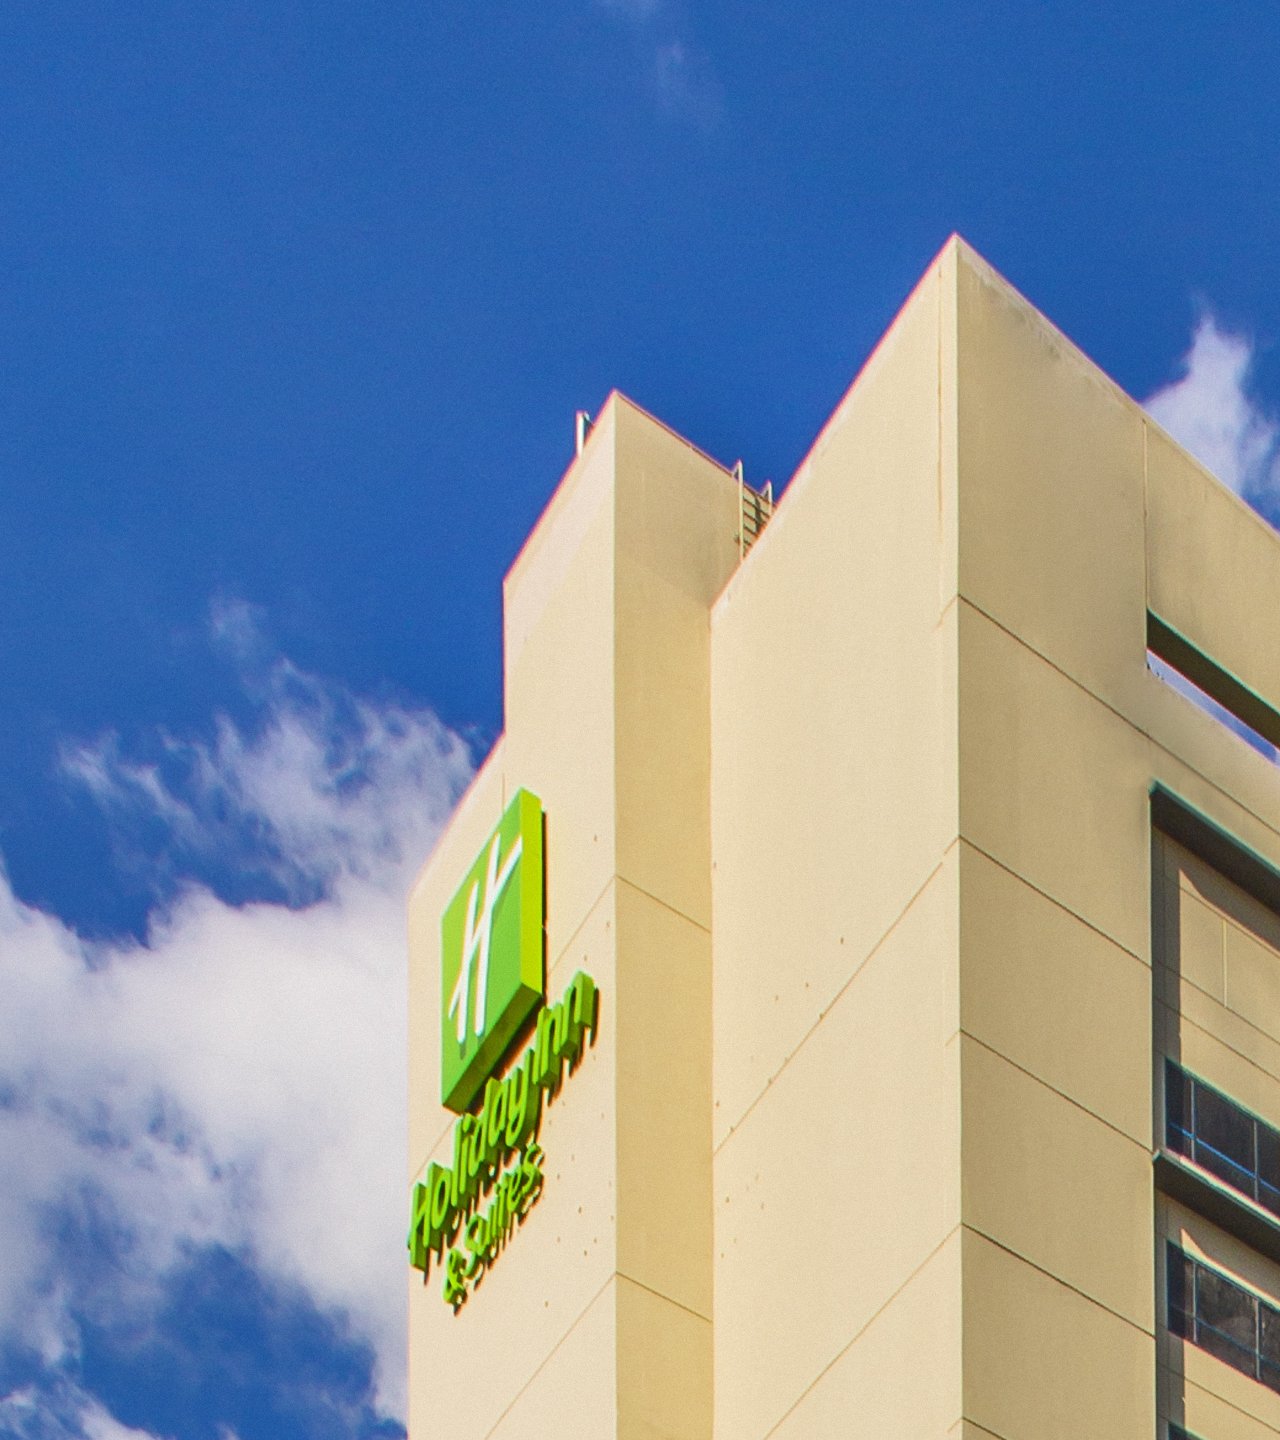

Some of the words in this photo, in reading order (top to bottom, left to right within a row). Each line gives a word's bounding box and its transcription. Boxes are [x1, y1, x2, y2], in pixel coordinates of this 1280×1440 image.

[408, 1048, 541, 1272] Holiday
[533, 969, 596, 1088] Inn
[443, 1246, 467, 1307] &
[463, 1142, 544, 1277] Suites
